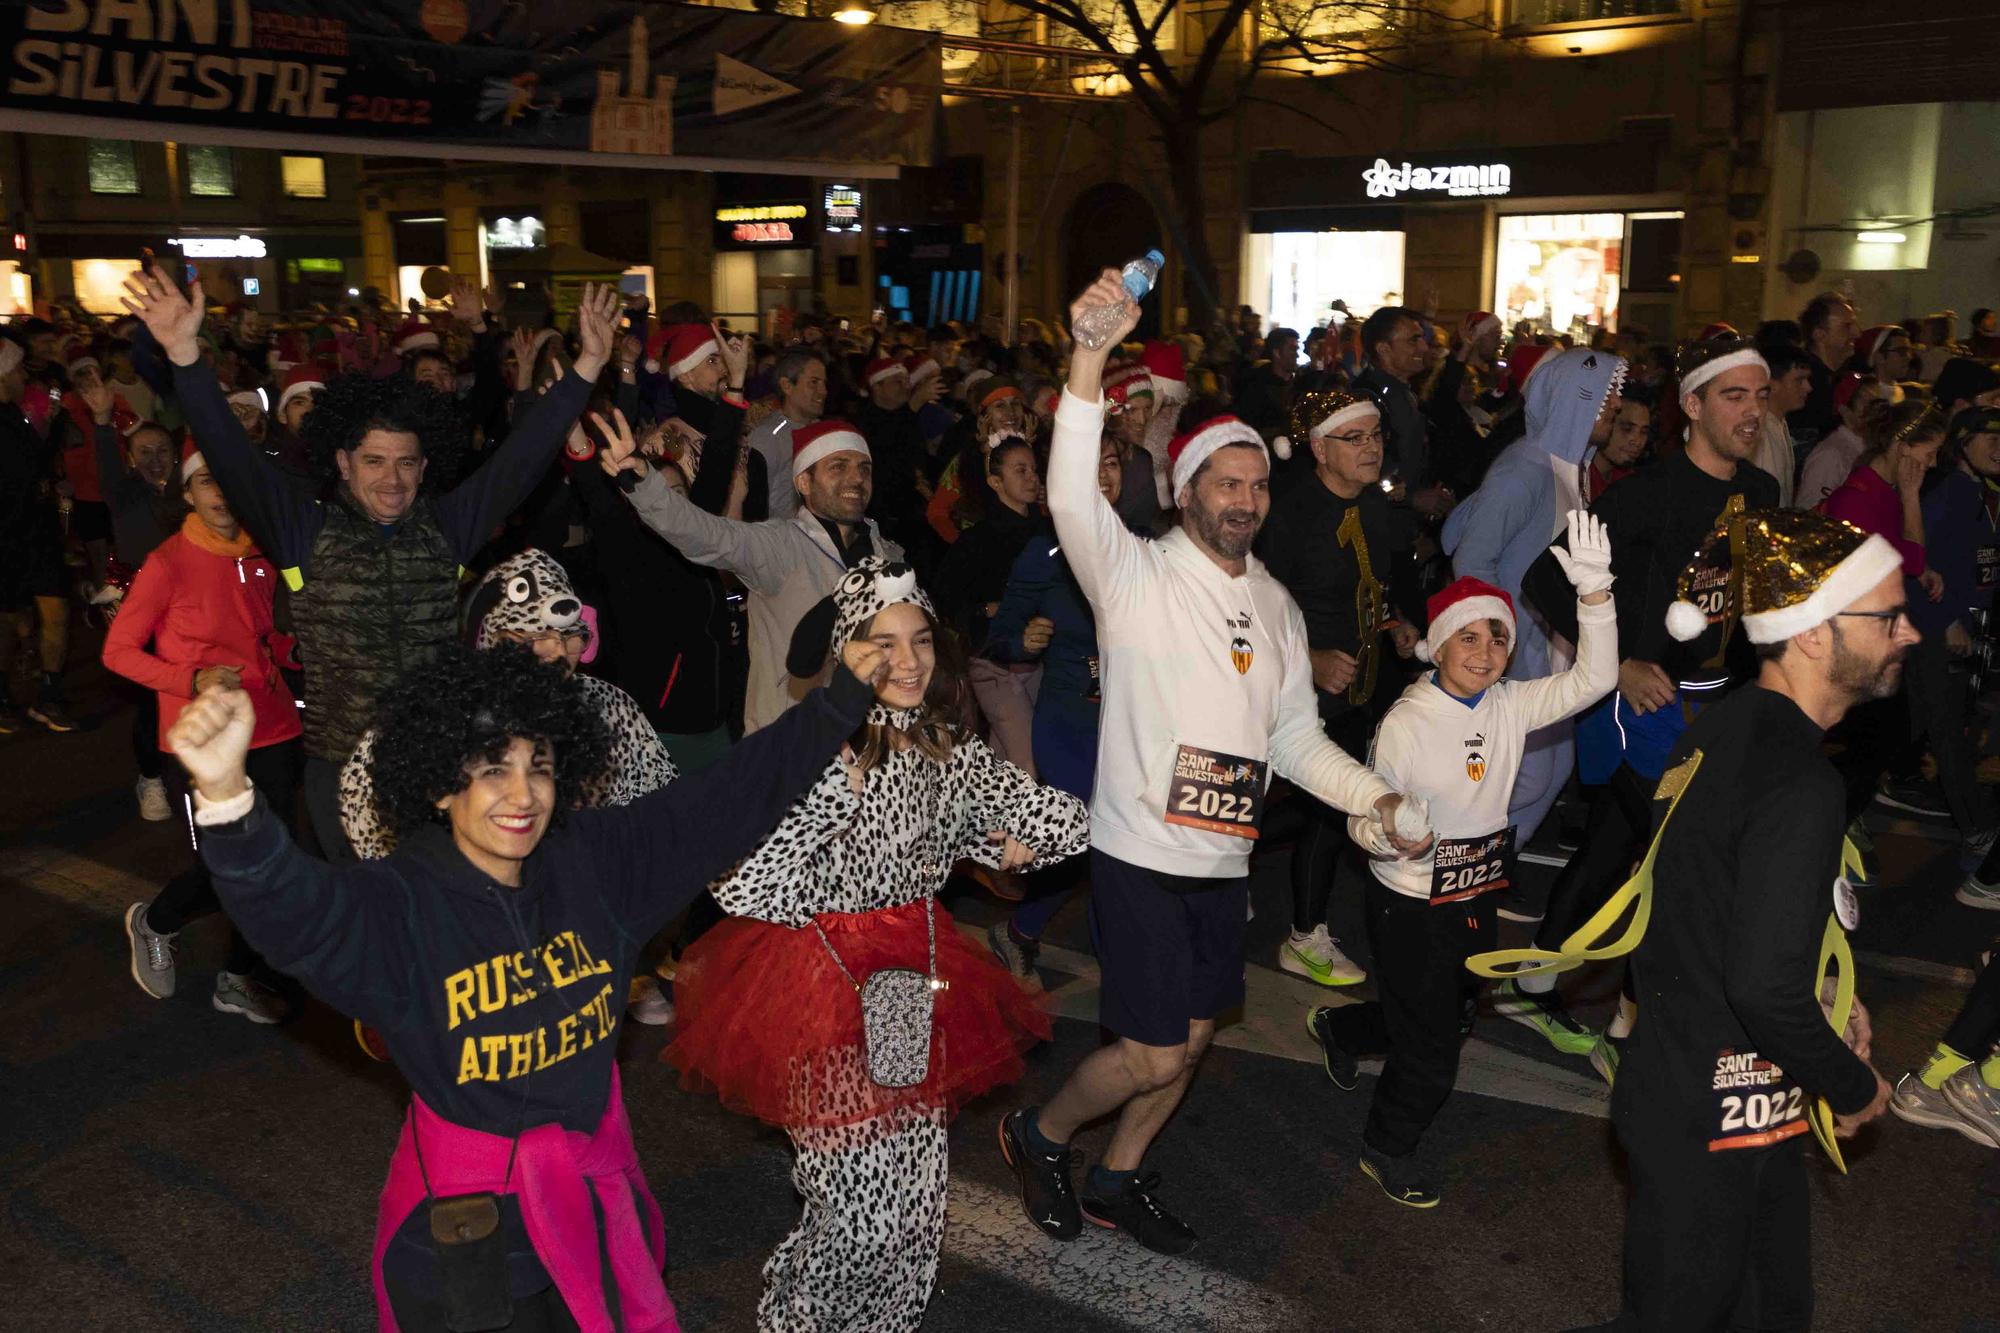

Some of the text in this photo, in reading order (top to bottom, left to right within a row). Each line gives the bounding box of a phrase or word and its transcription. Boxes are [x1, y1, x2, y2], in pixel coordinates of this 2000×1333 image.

[346, 95, 432, 125] 2022
[1177, 752, 1217, 772] SANT
[1178, 785, 1254, 822] 2022
[1437, 844, 1470, 859] SANT
[1440, 859, 1503, 893] 2022
[457, 983, 616, 1085] ATHLETIC
[1715, 1052, 1757, 1075] SANT
[1721, 1086, 1802, 1131] 2022
